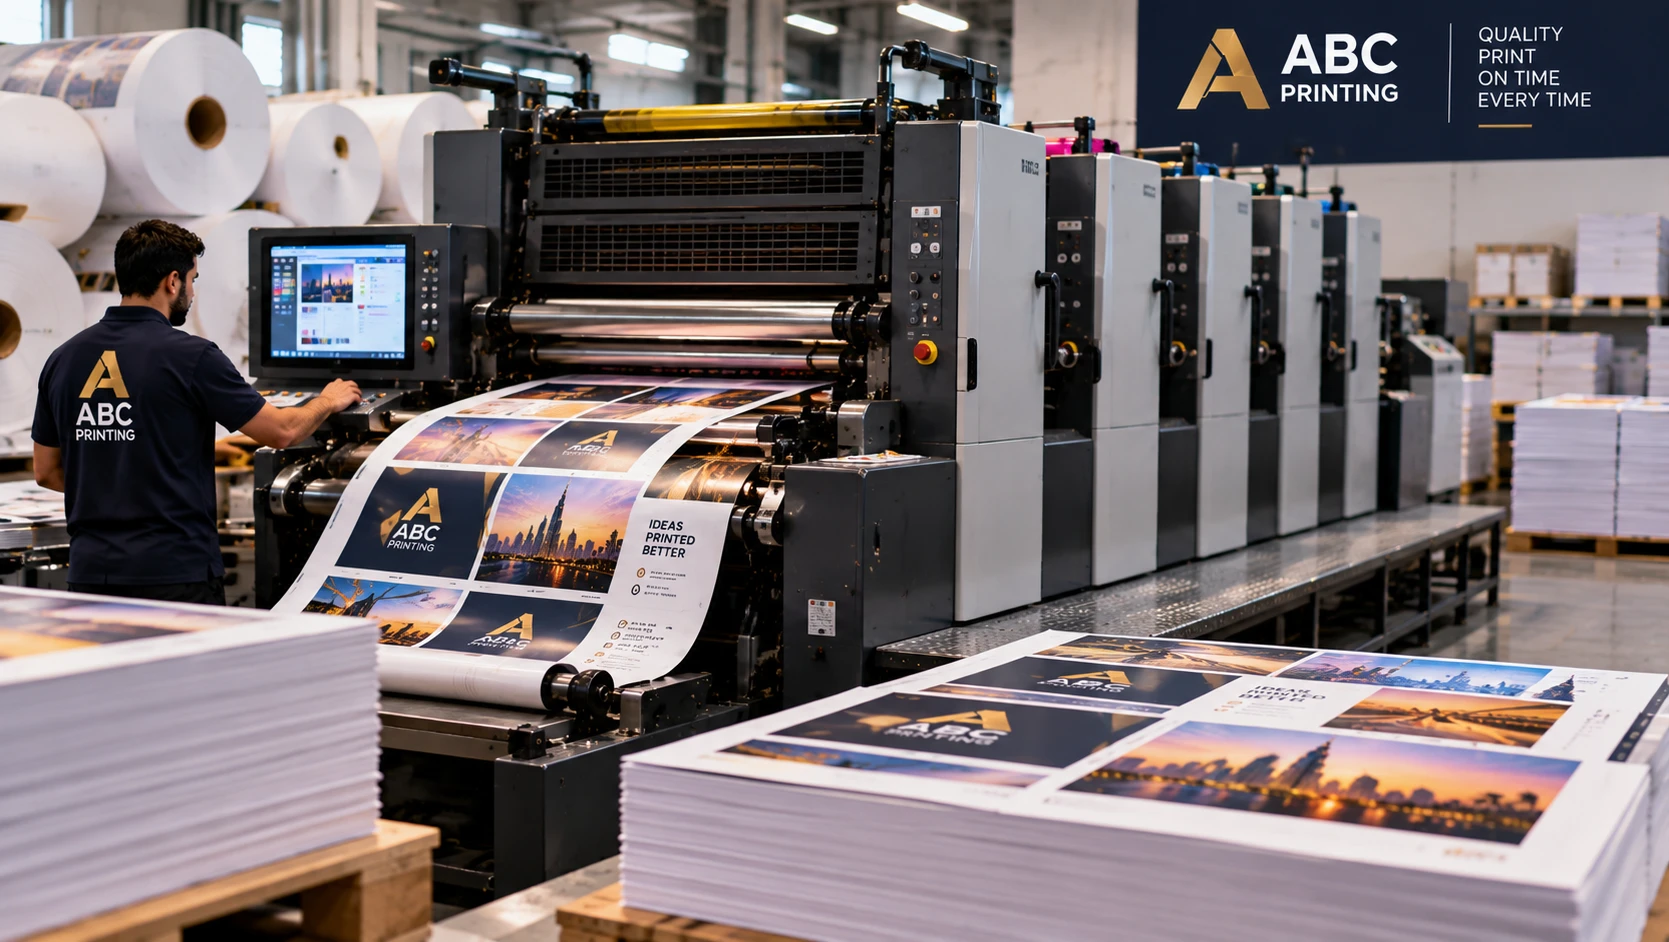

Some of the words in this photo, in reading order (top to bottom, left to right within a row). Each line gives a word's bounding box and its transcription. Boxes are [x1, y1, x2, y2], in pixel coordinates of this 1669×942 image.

[1478, 26, 1563, 43] QUALITY
[1281, 32, 1398, 74] ABC
[1479, 48, 1536, 64] PRINT
[1478, 70, 1508, 86] ON
[1514, 70, 1560, 86] TIME
[1281, 83, 1398, 102] PRINTING
[1478, 92, 1540, 107] EVERY
[1546, 92, 1592, 107] TIME
[76, 402, 133, 426] ABC
[76, 429, 136, 441] PRINTING
[392, 523, 441, 541] ABC
[649, 519, 684, 531] IDEAS
[386, 539, 435, 552] PRINTING
[645, 532, 696, 545] PRINTED
[642, 545, 686, 558] BETTER
[897, 723, 1008, 740] ABC
